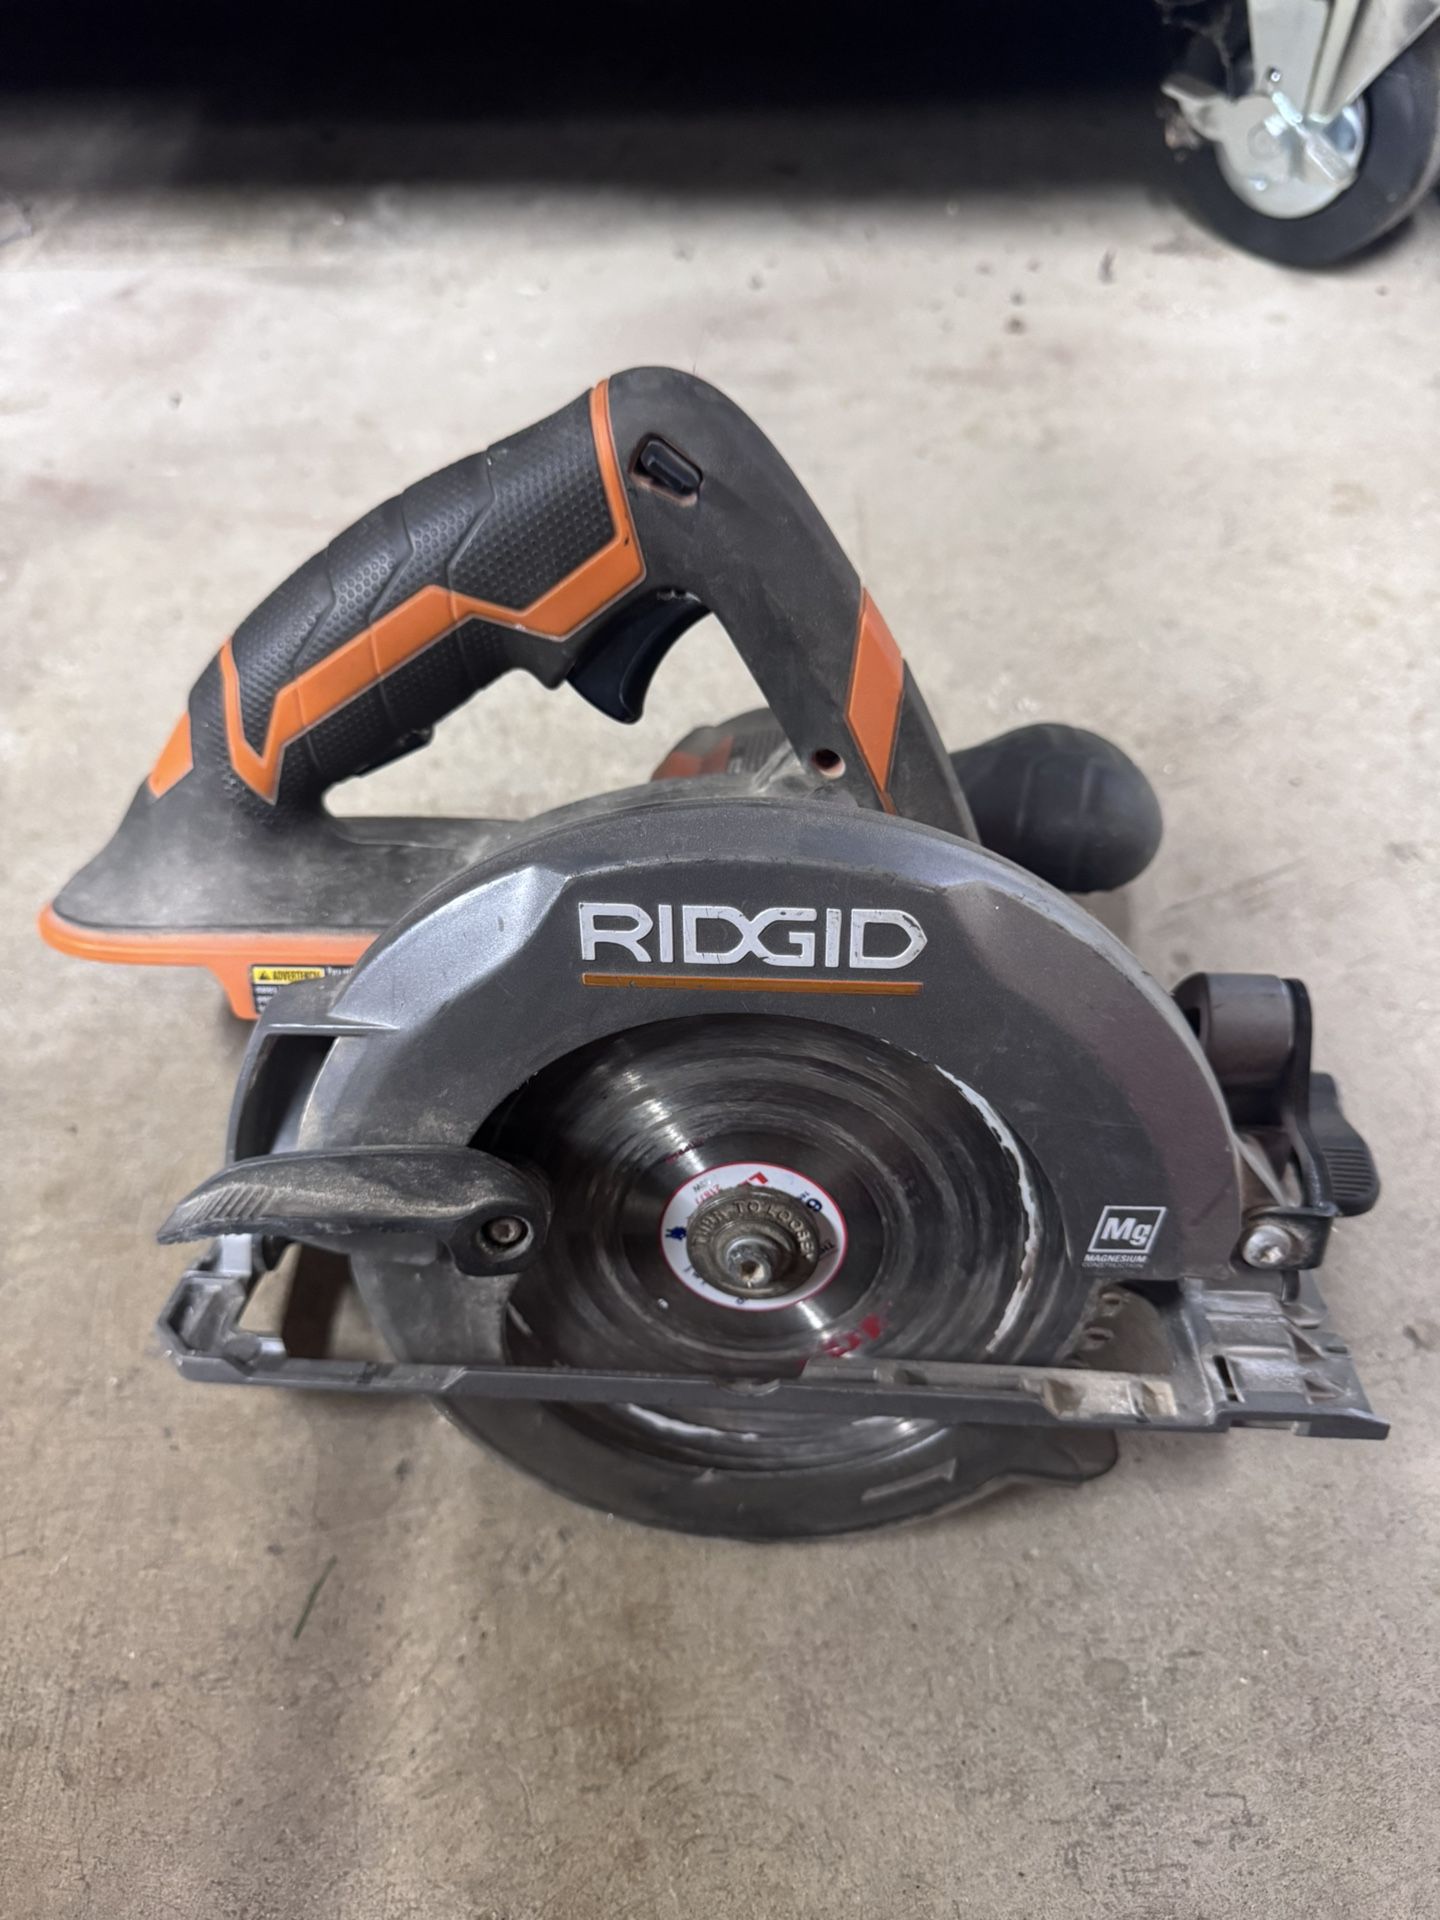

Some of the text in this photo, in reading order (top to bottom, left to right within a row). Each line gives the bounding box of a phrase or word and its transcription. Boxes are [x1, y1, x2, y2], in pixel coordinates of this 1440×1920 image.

[578, 901, 928, 970] RIDGID
[732, 1199, 763, 1215] TO
[1100, 1217, 1152, 1246] Mg
[1083, 1254, 1148, 1262] MAGNESIUM
